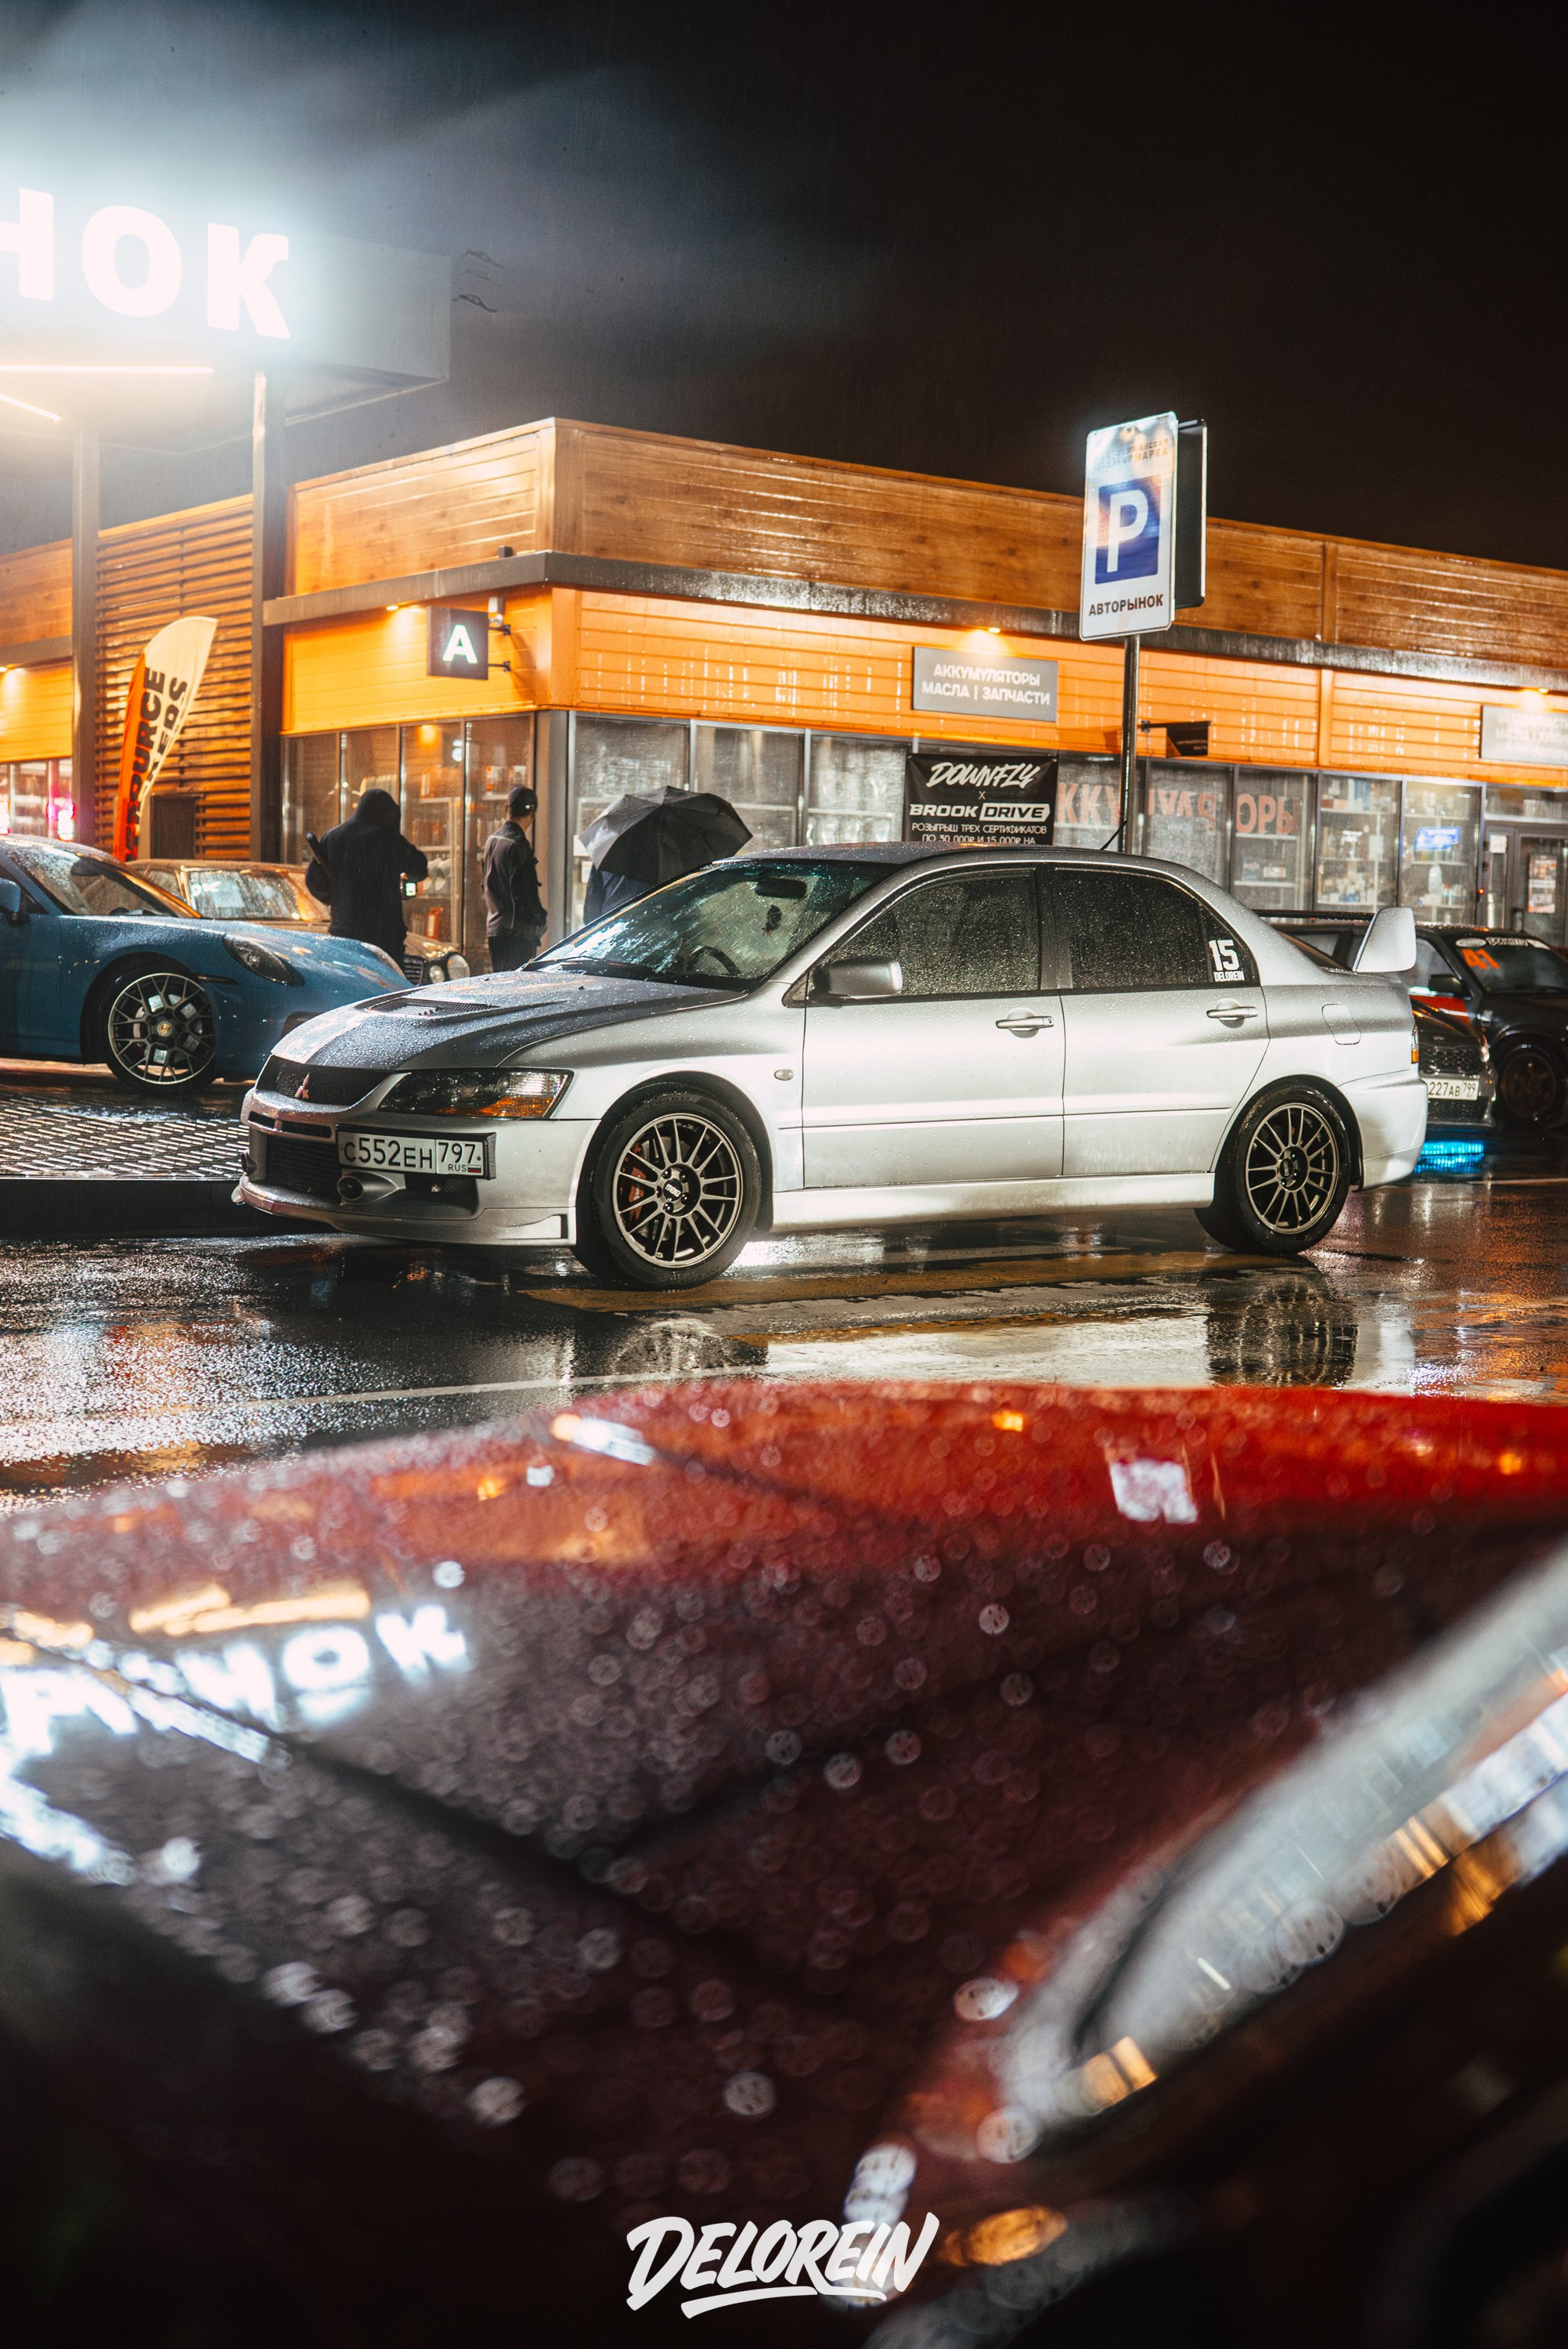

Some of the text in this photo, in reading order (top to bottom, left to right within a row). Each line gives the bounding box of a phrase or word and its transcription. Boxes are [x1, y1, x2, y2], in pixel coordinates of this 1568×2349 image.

[1107, 489, 1148, 572] P
[1088, 594, 1164, 616] АВТОРЫНОК
[932, 664, 1040, 687] АККУМУЛЯТОРЫ
[921, 681, 970, 698] МАСЛА
[982, 687, 1051, 705] ЗАПЧАСТИ
[909, 804, 1045, 818] BROOK DRIVE
[912, 823, 1047, 835] РОЗЫГРЫШ ТРЕХ СЕРТИФИКАТОВ
[922, 834, 936, 843] ПО
[1209, 940, 1240, 971] 15
[1462, 948, 1501, 969] 41
[438, 1142, 476, 1164] 797
[448, 1164, 467, 1172] RUS
[665, 1184, 682, 1198] BBS
